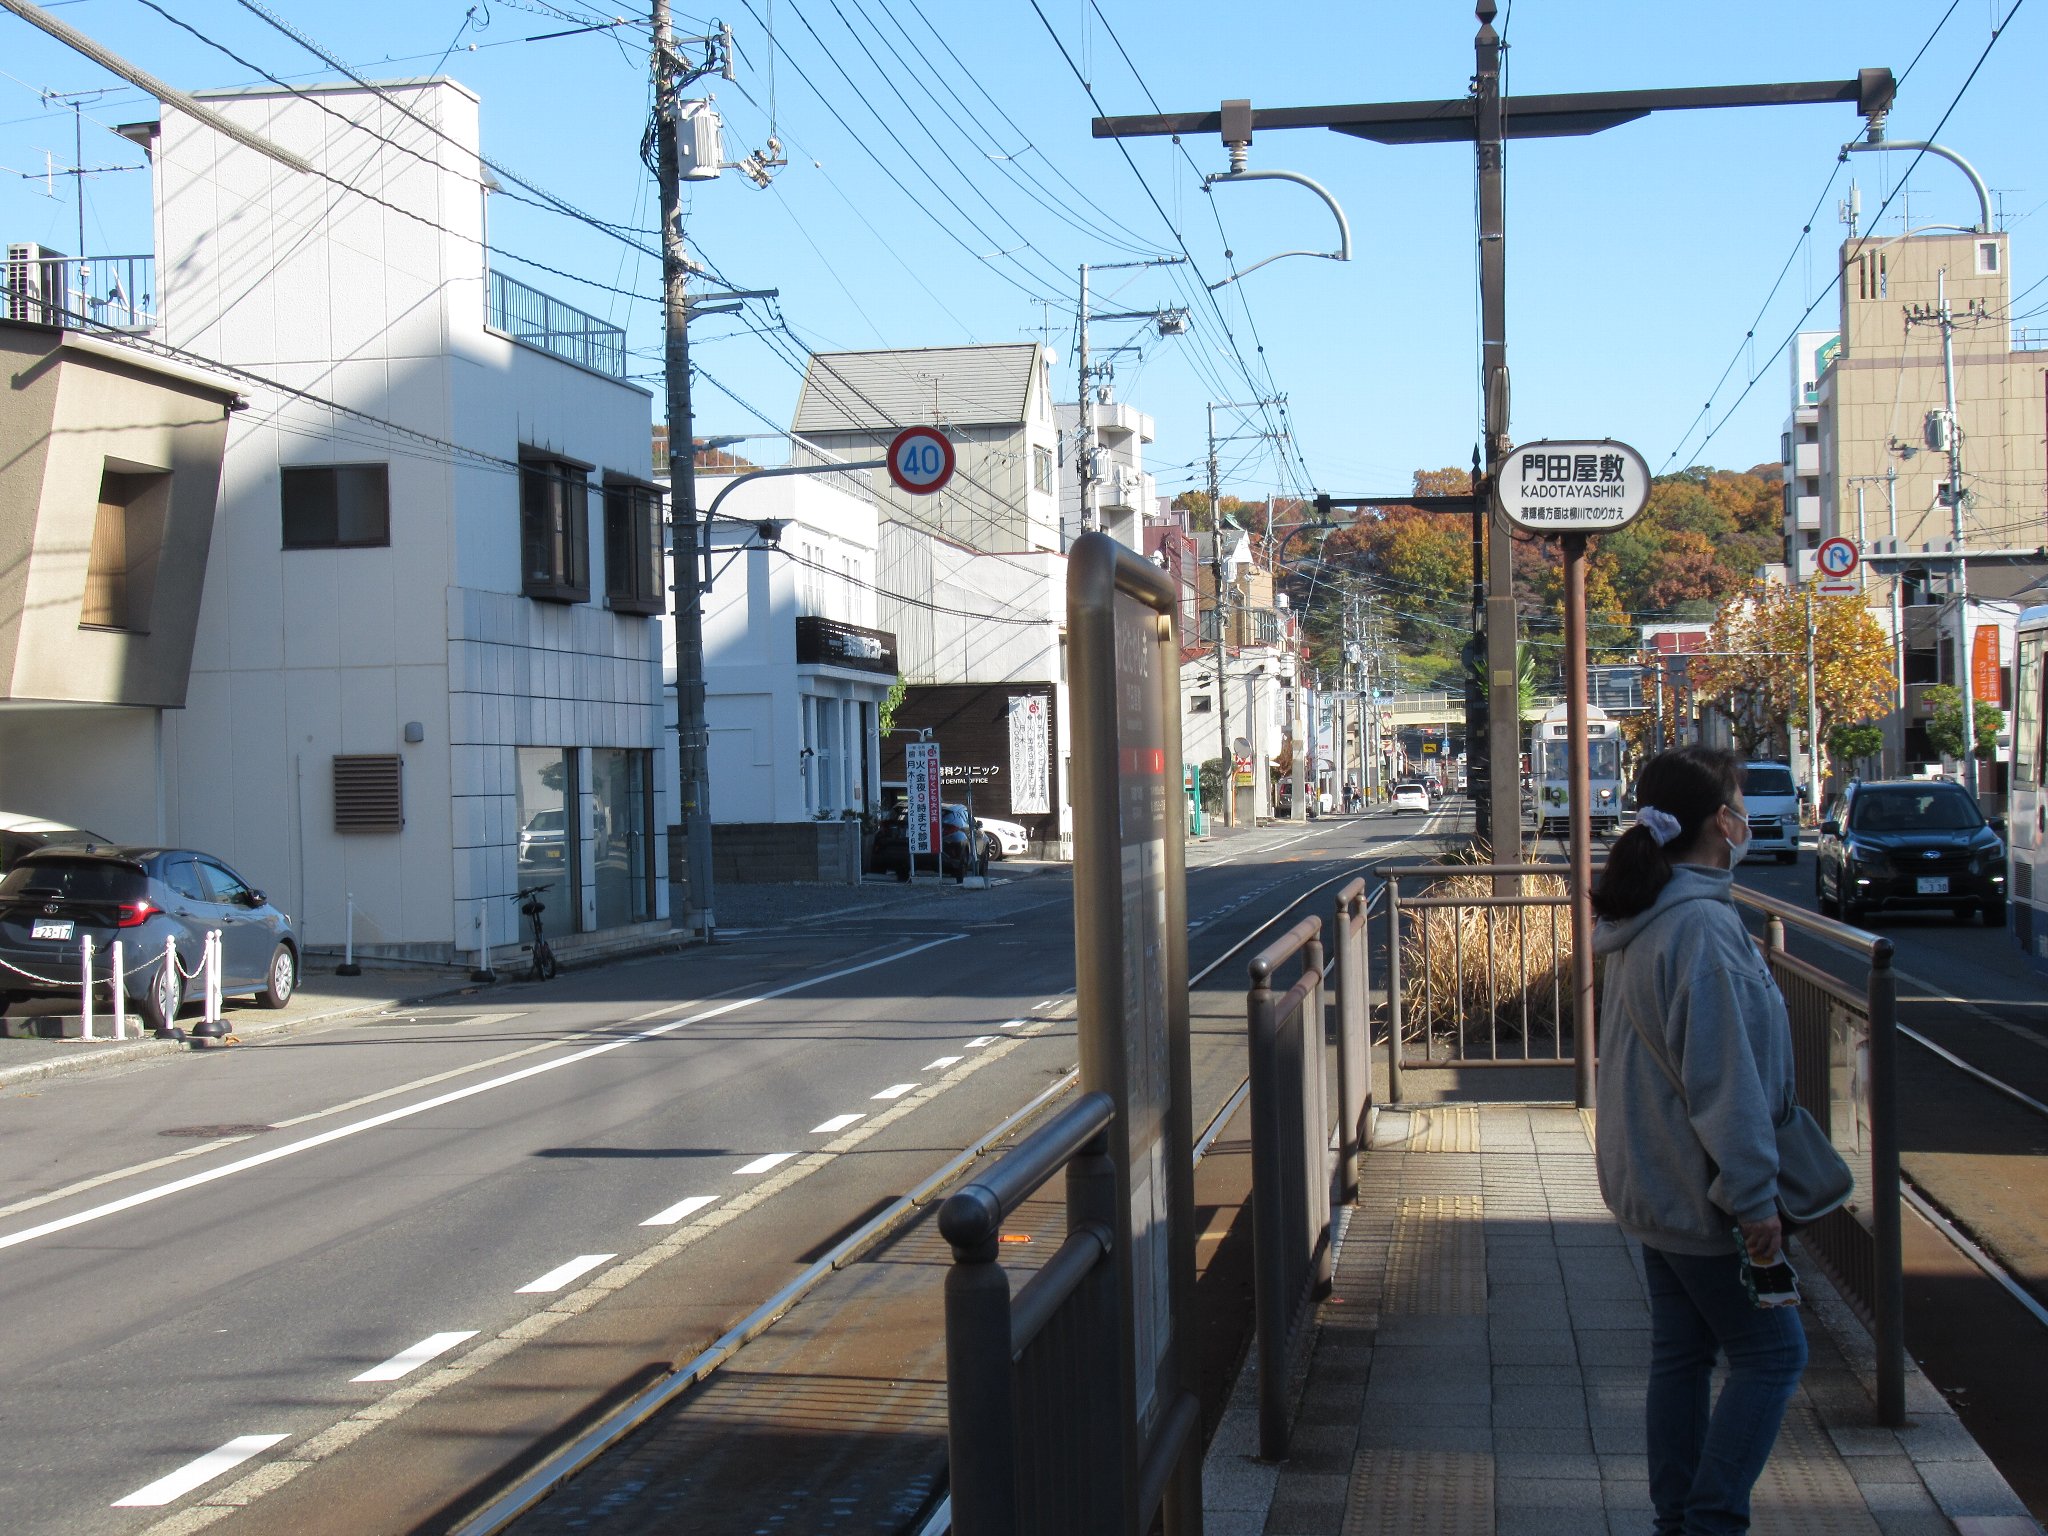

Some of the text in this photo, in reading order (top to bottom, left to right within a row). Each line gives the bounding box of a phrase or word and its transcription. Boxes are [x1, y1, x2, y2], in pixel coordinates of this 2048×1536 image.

[904, 445, 939, 475] 40
[1522, 454, 1625, 482] 門田屋敷
[1521, 485, 1625, 498] KADOTAYASHIKI
[1521, 507, 1625, 520] 清輝橋方面は柳川でのりかえ
[929, 760, 939, 823] 予約なくても大丈夫
[41, 927, 71, 938] 23-17
